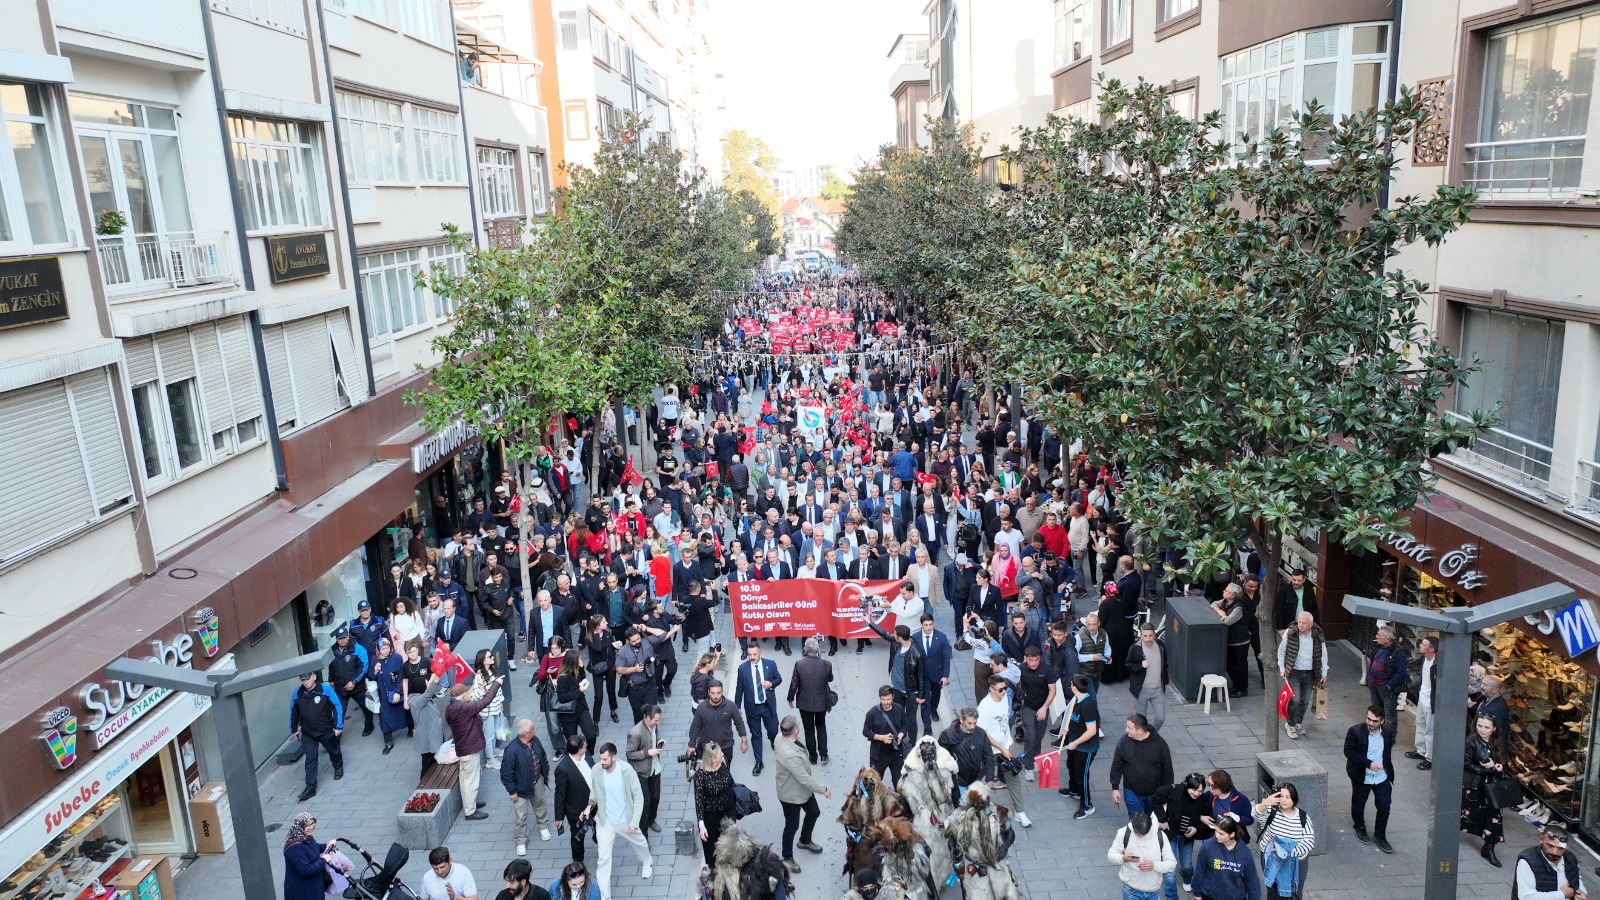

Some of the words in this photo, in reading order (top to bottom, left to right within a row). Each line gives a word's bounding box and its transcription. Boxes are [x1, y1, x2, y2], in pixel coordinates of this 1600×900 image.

[295, 243, 317, 255] AVUKAT
[0, 272, 39, 290] VUKAT
[11, 289, 62, 312] ZENGİN
[739, 584, 761, 593] 10.10
[740, 593, 768, 602] Dünya
[794, 600, 817, 609] Günü
[742, 611, 764, 619] Kutlu
[765, 610, 791, 619] Olsun
[48, 707, 69, 726] vicco
[97, 713, 129, 746] ÇOCUK
[131, 687, 170, 718] AYAKKA
[44, 780, 101, 834] Subebe
[202, 819, 210, 837] vicco
